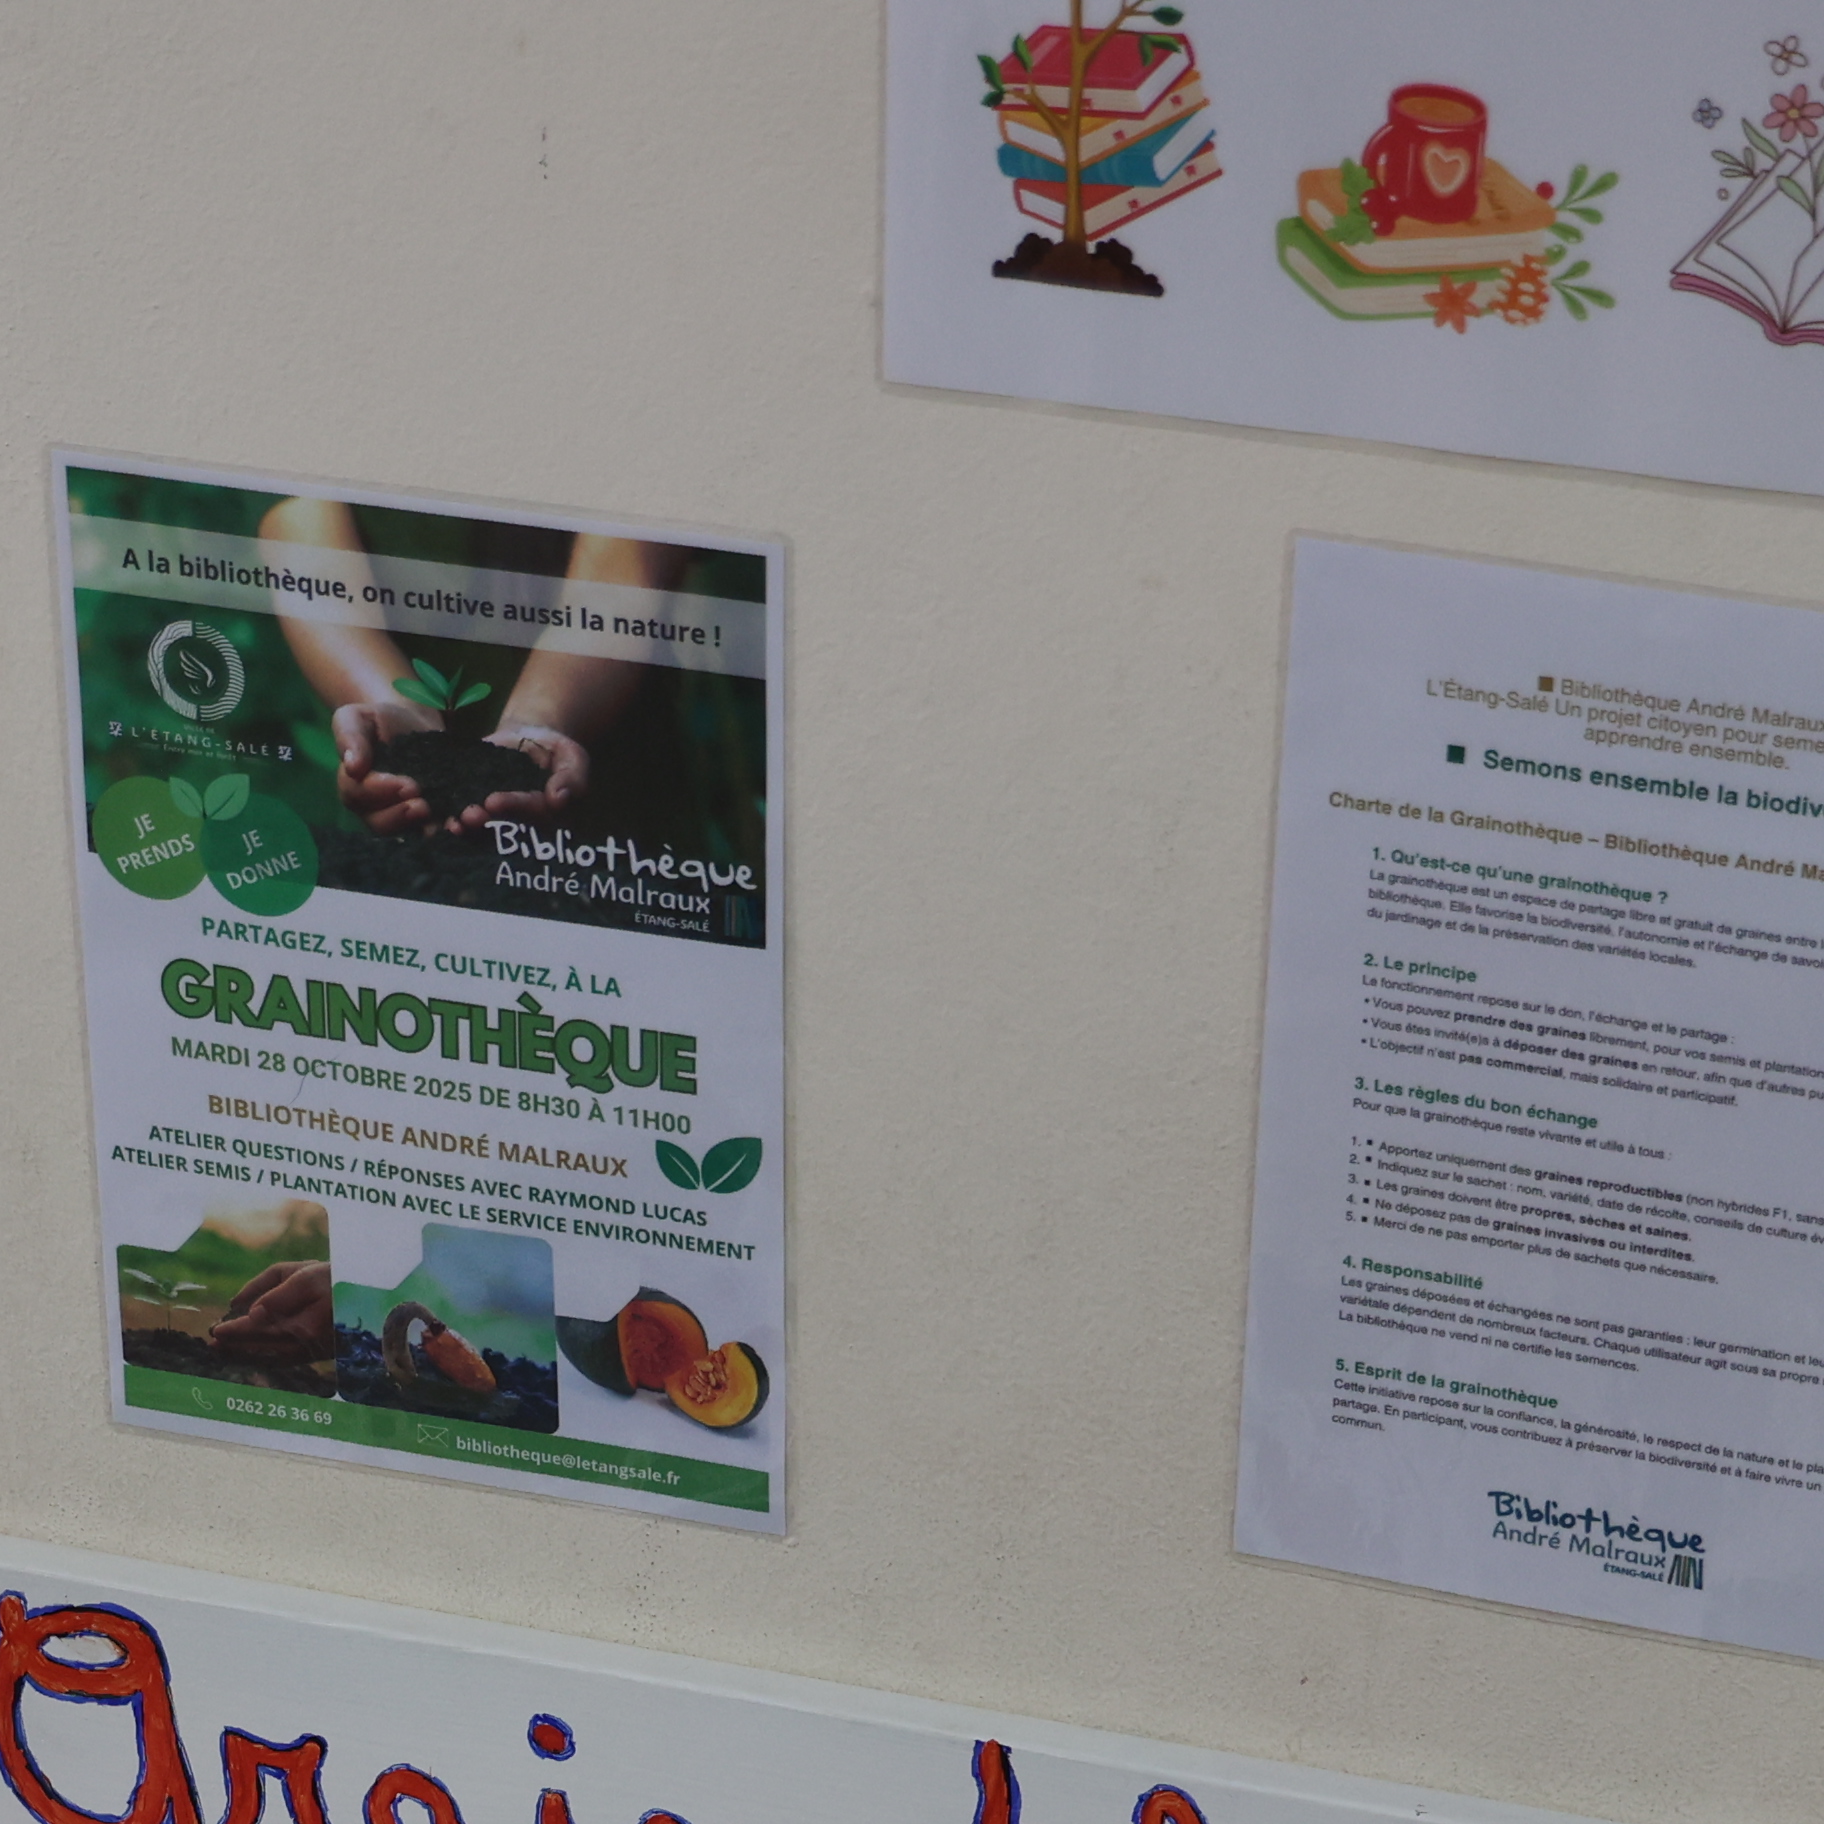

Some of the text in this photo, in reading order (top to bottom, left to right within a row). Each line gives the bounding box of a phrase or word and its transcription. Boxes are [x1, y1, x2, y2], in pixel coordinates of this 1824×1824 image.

[122, 548, 720, 647] A la bibliothèque, on cultive aussi la nature !
[1426, 679, 1550, 713] L'Étang-Salé
[1555, 698, 1582, 718] Un
[1587, 707, 1643, 728] projet
[1647, 714, 1717, 738] citoyen
[1722, 727, 1769, 745] pour
[1561, 678, 1681, 713] Bibliothèque
[1686, 697, 1746, 722] André
[1583, 727, 1790, 770] apprendre ensemble.
[1483, 749, 1582, 782] Semons
[1589, 770, 1710, 801] ensemble
[1717, 784, 1738, 806] la
[116, 833, 195, 874] PRENDS
[134, 814, 155, 839] JE
[242, 830, 263, 856] JE
[1329, 791, 1393, 815] Charte
[1398, 803, 1422, 820] de
[1427, 806, 1445, 823] la
[1450, 810, 1583, 845] Grainothèque
[1604, 833, 1730, 867] Bibliothèque
[1734, 853, 1796, 877] André
[226, 851, 302, 890] DONNE
[484, 820, 757, 893] Bibliothèque
[1373, 847, 1668, 904] 1. Qu'est-ce qu'une grainothèque ?
[496, 861, 710, 914] André Malraux
[201, 917, 622, 998] PARTAGEZ, SEMEZ, CULTIVEZ, À LA
[1363, 953, 1477, 983] 2. Le principe
[160, 957, 698, 1096] GRAINOTHÈQUE
[171, 1036, 691, 1135] MARDI 28 OCTOBRE 2025 DE 8H30 À 11H00
[1354, 1076, 1598, 1130] 3. Les règles du bon échange
[208, 1094, 628, 1178] BIBLIOTHÈQUE ANDRÉ MALRAUX
[111, 1145, 756, 1261] ATELIER SEMIS / PLANTATION AVEC LE SERVICE ENVIRONNEMENT
[149, 1125, 707, 1227] ATELIER QUESTIONS / RÉPONSES AVEC RAYMOND LUCAS
[1342, 1255, 1483, 1290] 4. Responsabilité
[1335, 1358, 1558, 1409] 5. Esprit de la grainothèque
[226, 1397, 332, 1425] 0262 26 36 69
[456, 1436, 681, 1485] bibliotheque@letangsale.fr
[1487, 1491, 1706, 1554] Bibliothèque
[1492, 1520, 1666, 1569] André Malraux
